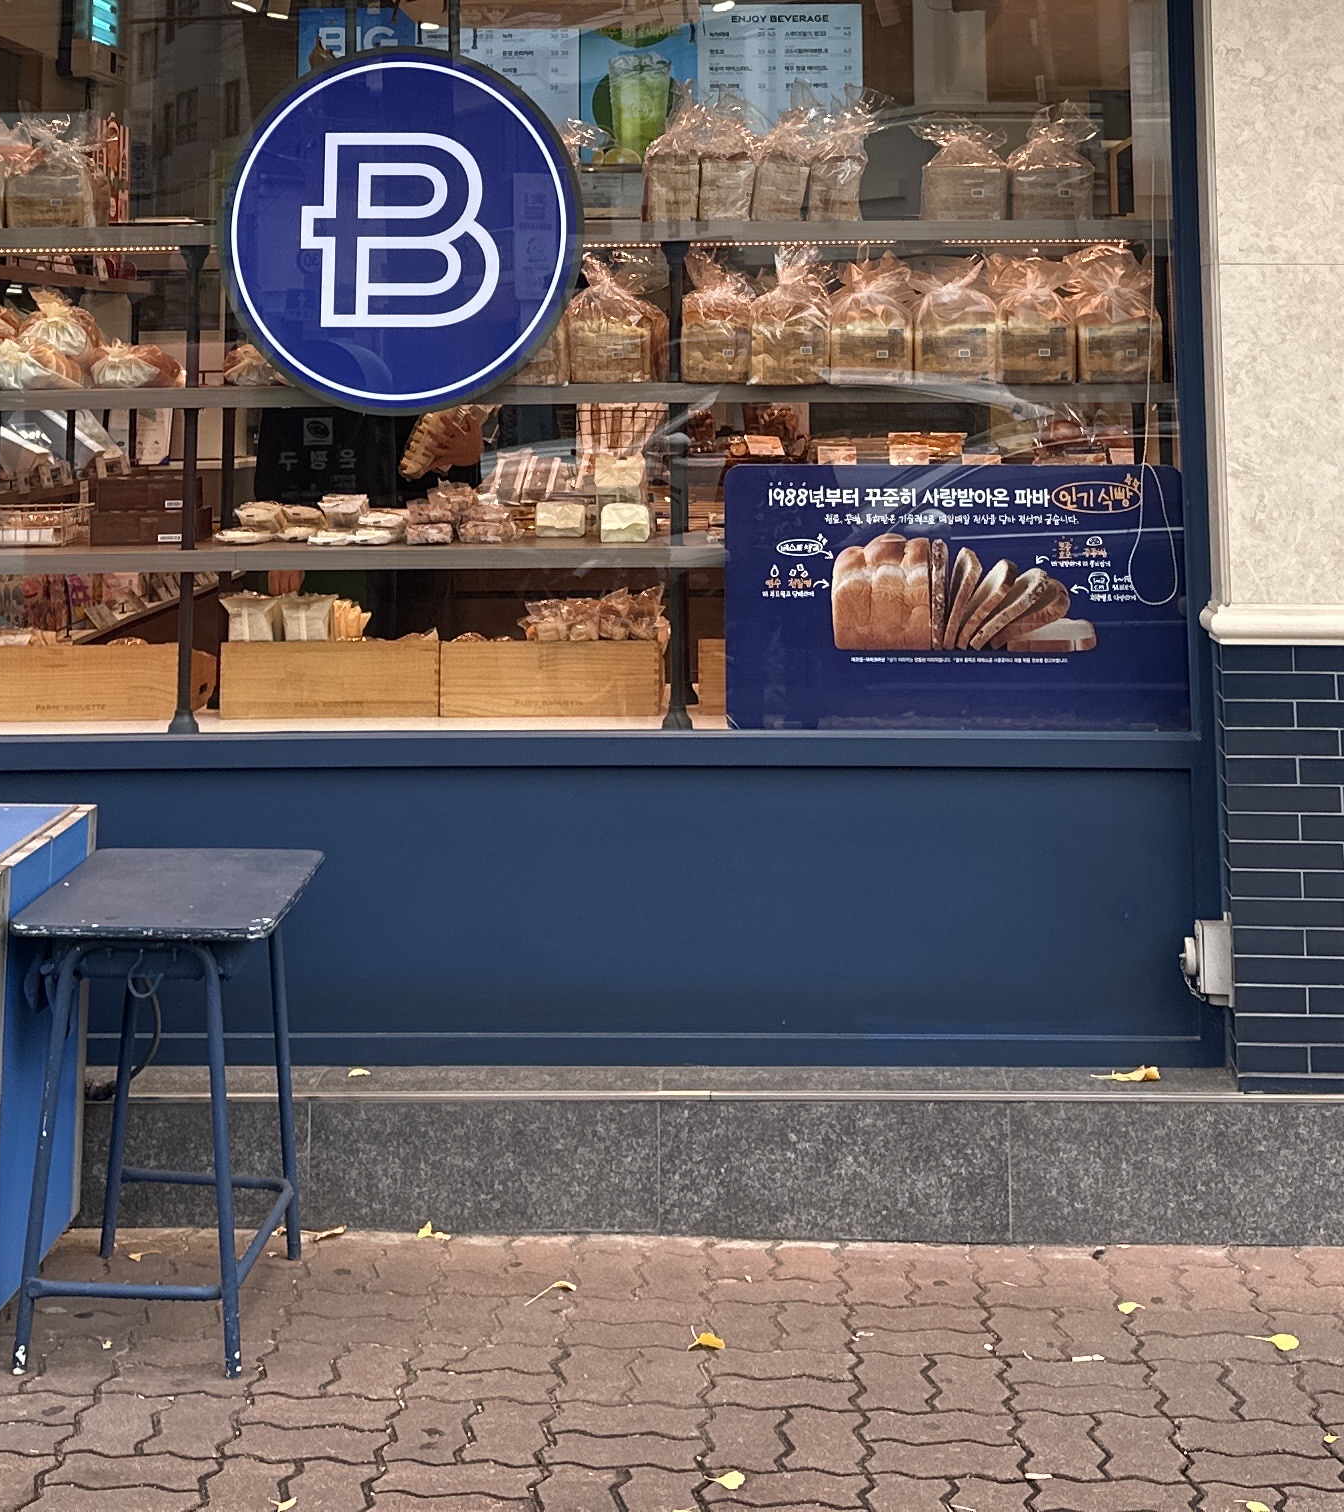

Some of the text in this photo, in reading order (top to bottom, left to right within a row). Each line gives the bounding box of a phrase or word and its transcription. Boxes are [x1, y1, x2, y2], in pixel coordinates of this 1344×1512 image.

[731, 14, 830, 23] ENJOY BEVERAGE
[768, 485, 859, 508] 1988년부터
[864, 487, 917, 508] 꾸준히
[921, 487, 1010, 508] 사랑받아온
[1014, 488, 1051, 508] 파바
[1097, 486, 1134, 512] 식빵
